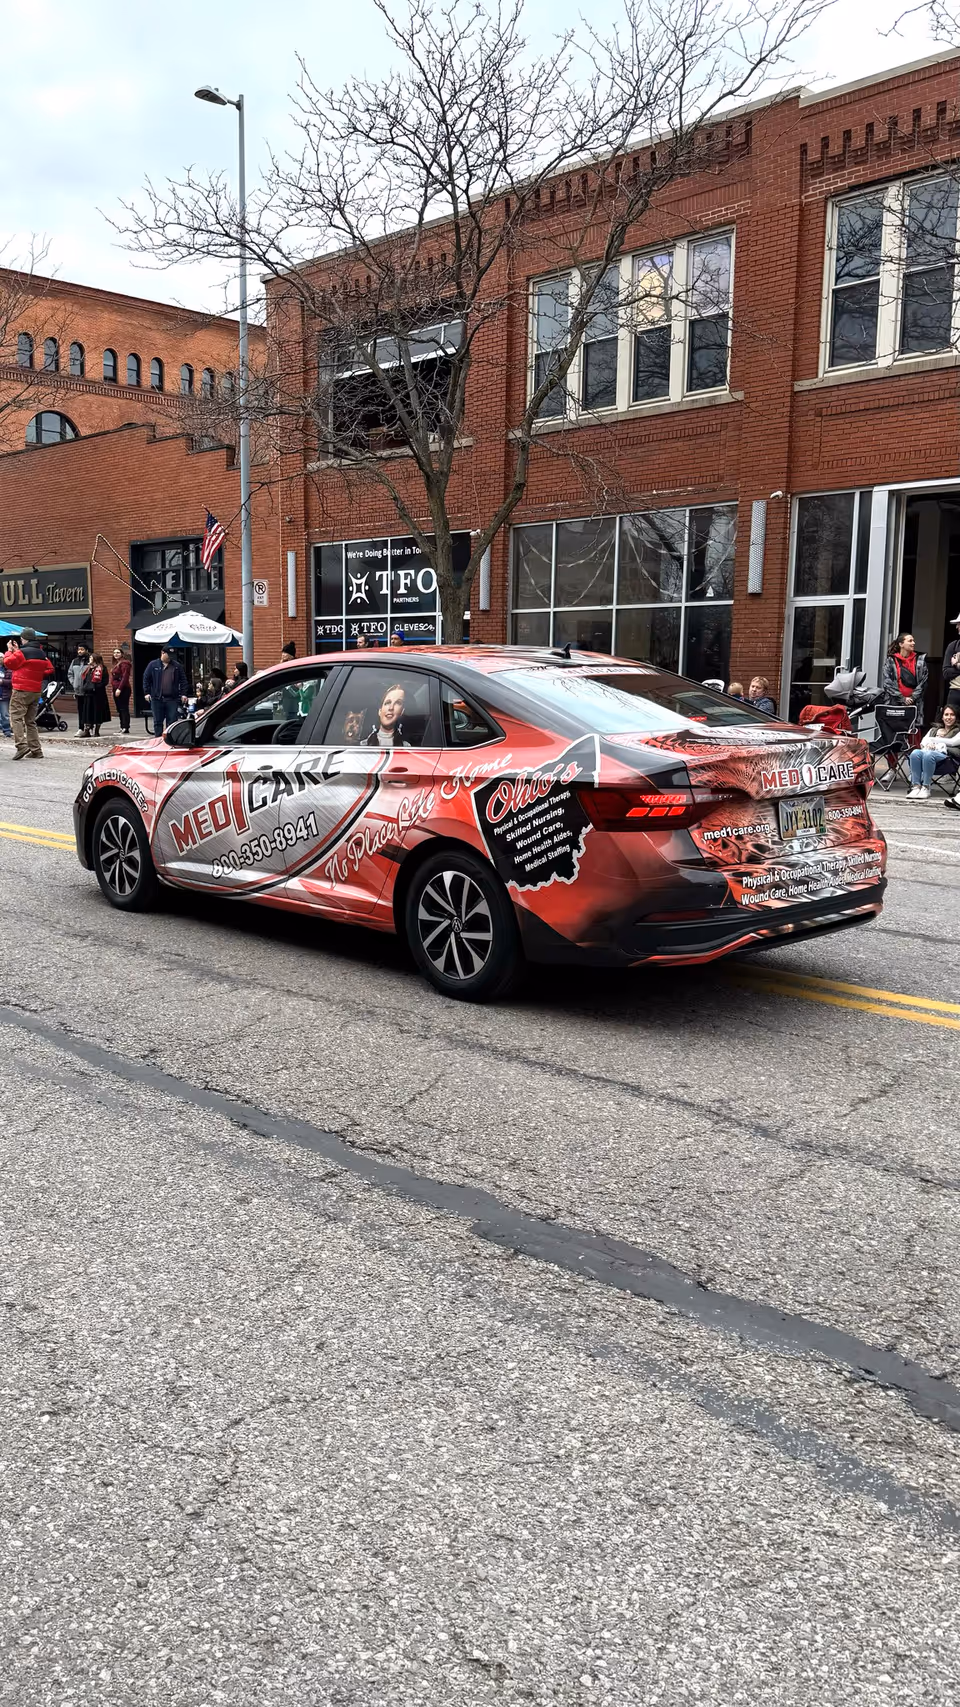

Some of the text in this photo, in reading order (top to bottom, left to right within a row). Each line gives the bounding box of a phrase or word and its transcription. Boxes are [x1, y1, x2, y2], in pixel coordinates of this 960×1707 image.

[347, 550, 363, 558] We're
[365, 548, 382, 558] Doing
[405, 546, 411, 555] in
[2, 578, 84, 606] ULL Tavern
[376, 568, 438, 594] TFO
[361, 622, 386, 633] TFO
[82, 776, 98, 803] GOT
[486, 761, 583, 824] Ohio's
[324, 852, 349, 888] No
[348, 823, 397, 872] Place
[440, 753, 513, 800] Home
[494, 819, 513, 836] Physical
[518, 802, 549, 822] Occupational
[506, 807, 564, 842] Skilled Nursing,
[704, 824, 770, 841] med1care.org
[784, 808, 823, 832] JYY 3102
[212, 811, 319, 879] 800-350-8941
[514, 830, 572, 864] Home Health Aides,
[516, 821, 564, 850] Wound Care,
[524, 844, 570, 872] Medical Staffing
[742, 873, 773, 889] Physical
[775, 872, 780, 882] &
[781, 862, 822, 880] Occupational
[848, 853, 864, 865] Skilled
[741, 892, 768, 906] Wound
[770, 888, 788, 900] Care,
[788, 884, 807, 896] Home
[808, 879, 828, 891] Health
